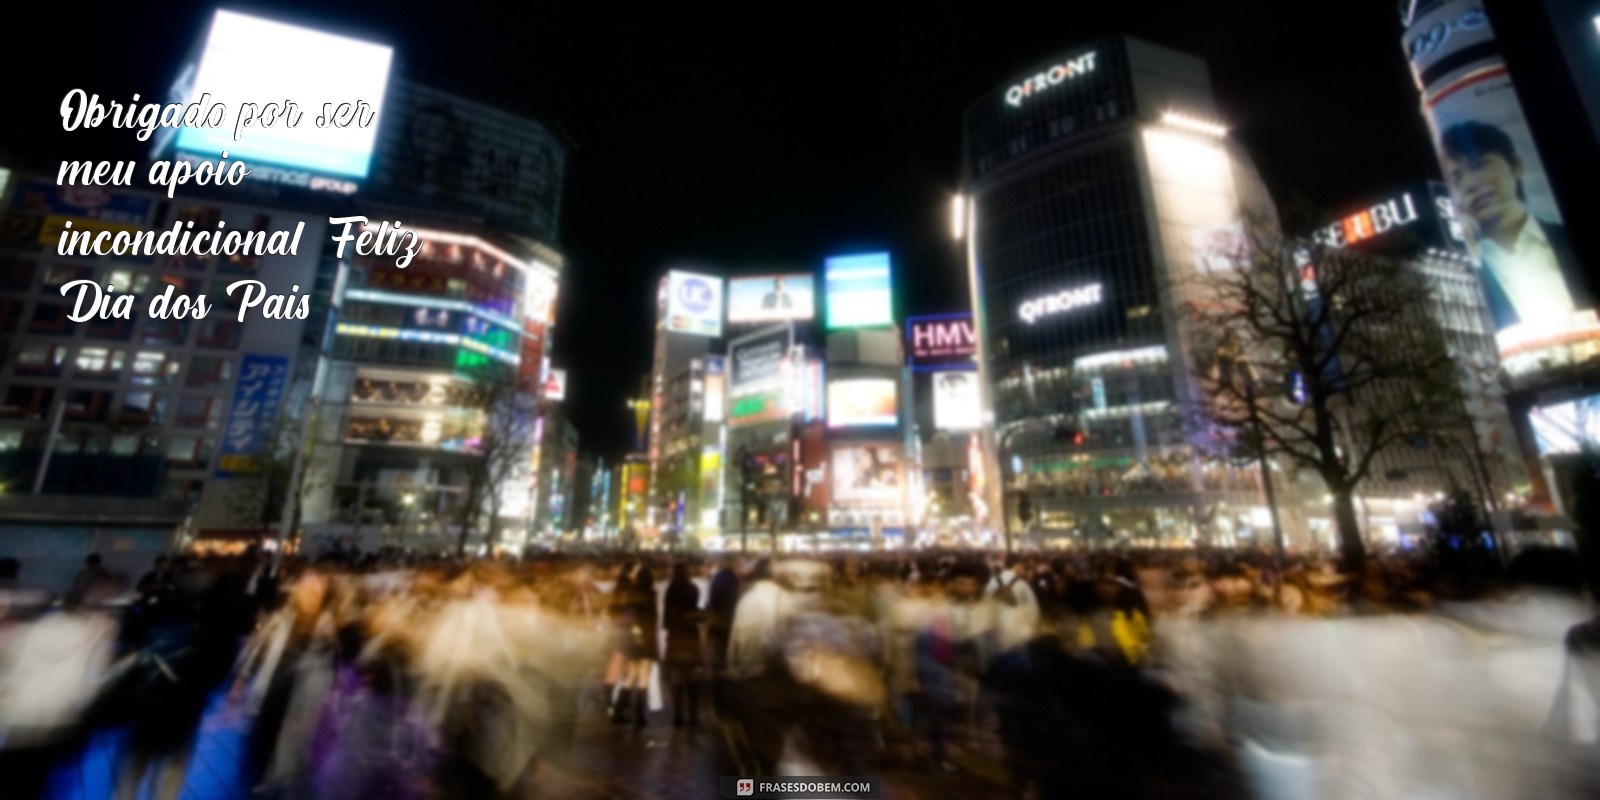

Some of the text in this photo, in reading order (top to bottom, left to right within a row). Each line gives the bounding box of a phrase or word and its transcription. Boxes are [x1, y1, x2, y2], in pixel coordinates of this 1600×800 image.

[1006, 51, 1096, 107] QFRONT
[1312, 192, 1419, 249] SEIBU
[1017, 282, 1103, 325] QFRONT
[914, 321, 976, 347] HMV
